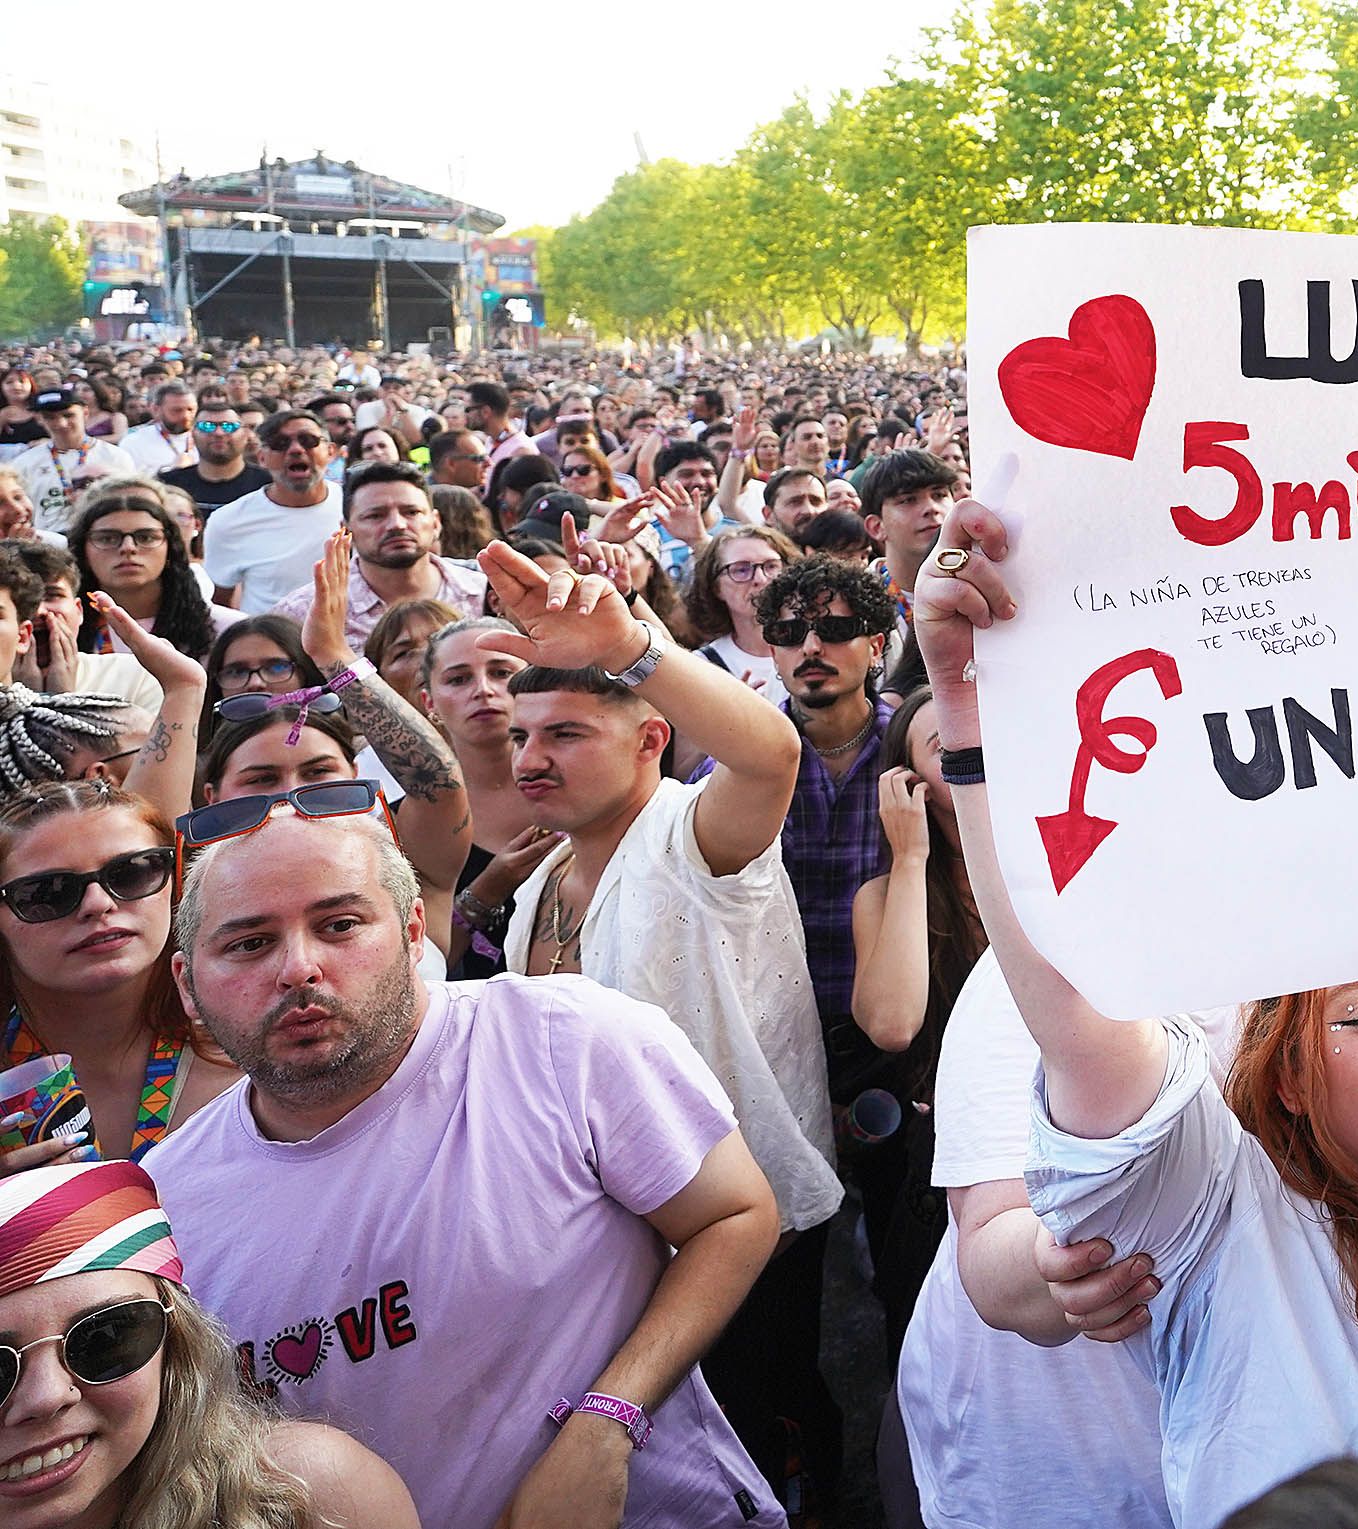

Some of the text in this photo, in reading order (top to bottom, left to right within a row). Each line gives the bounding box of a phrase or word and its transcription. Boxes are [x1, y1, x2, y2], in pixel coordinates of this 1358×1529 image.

[1130, 575, 1191, 607] NIÑA
[1202, 576, 1230, 596] DE
[1201, 600, 1276, 626] AZULES
[1197, 612, 1317, 650] TE TIENE UN
[1203, 688, 1355, 801] UN
[584, 1397, 619, 1413] FRONT
